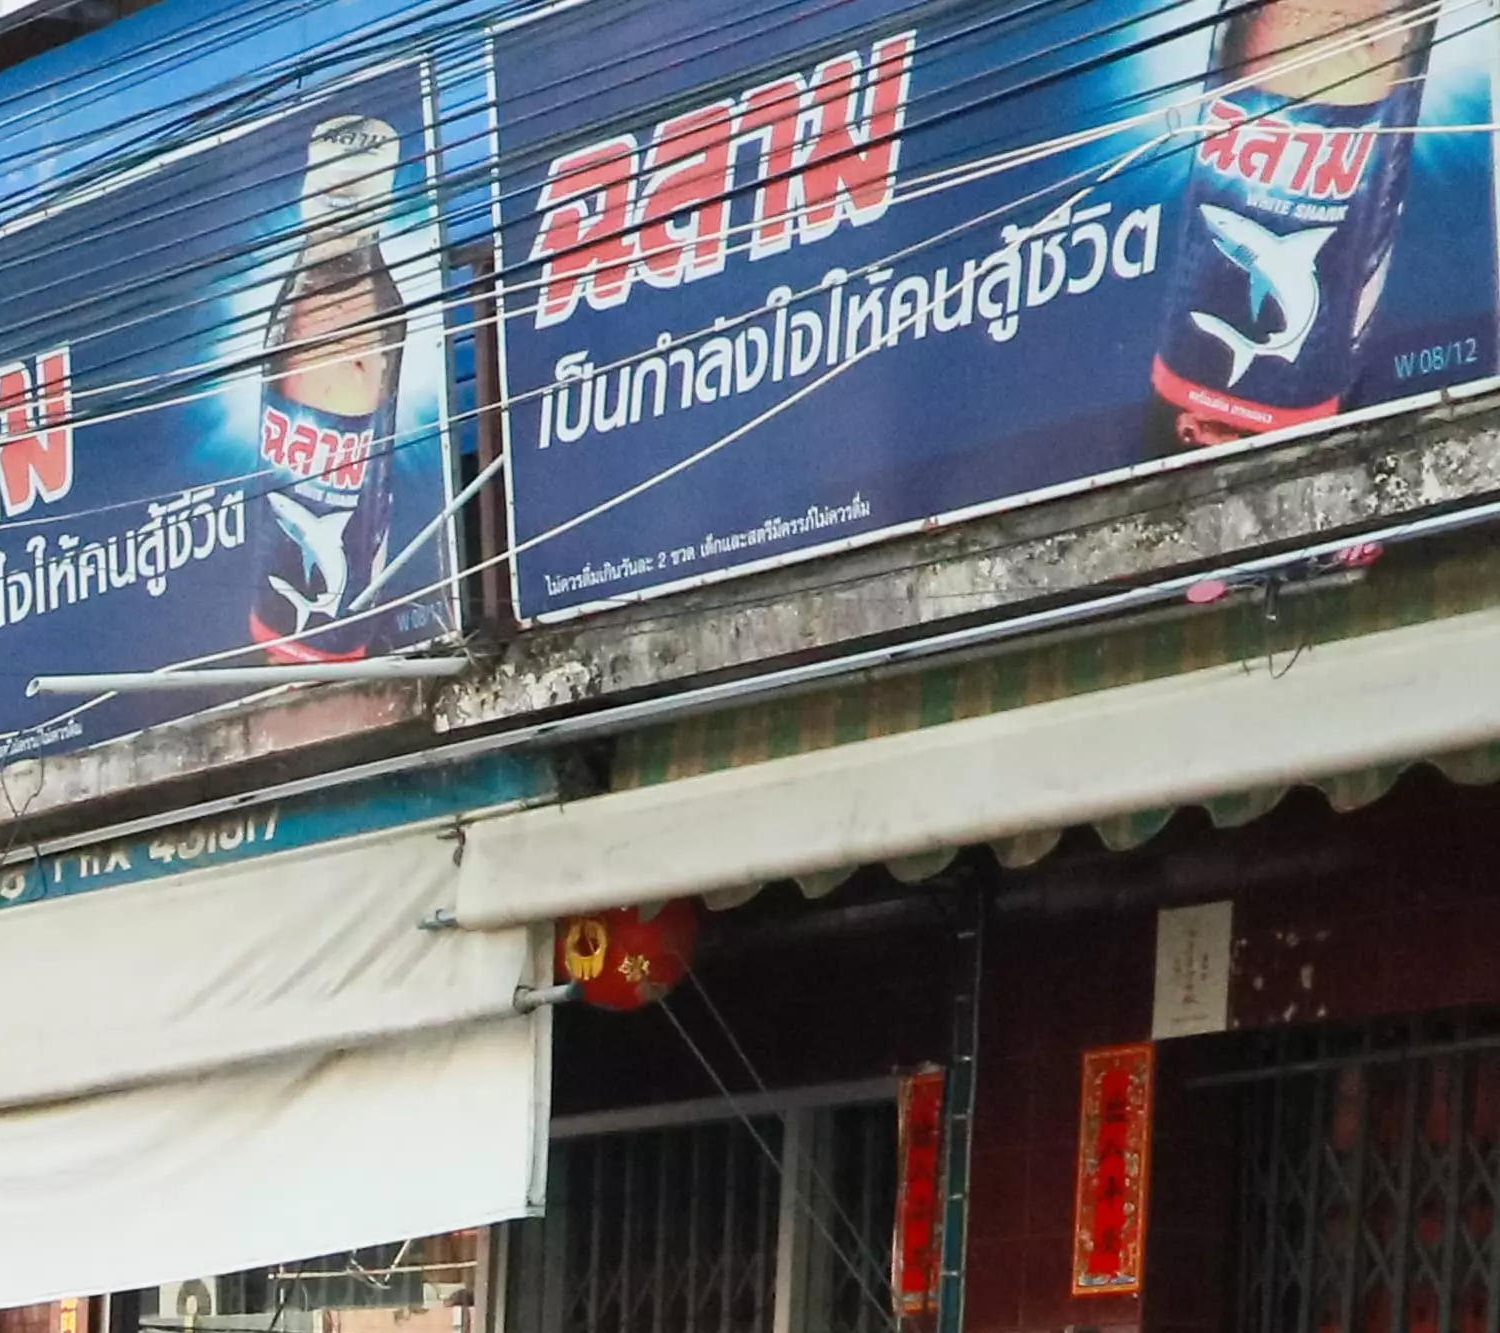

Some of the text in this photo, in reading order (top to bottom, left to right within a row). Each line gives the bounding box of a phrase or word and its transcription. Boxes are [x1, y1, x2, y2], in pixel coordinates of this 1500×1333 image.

[527, 29, 917, 330] ฉลาม
[1198, 97, 1380, 199] ฉลาม
[538, 202, 1163, 449] เป็นกำลังใจให้คนสู้ชีวิต
[1395, 338, 1477, 378] W 08/12
[261, 405, 374, 490] ฉลาม
[658, 551, 667, 569] 2
[669, 546, 696, 565] ขวด
